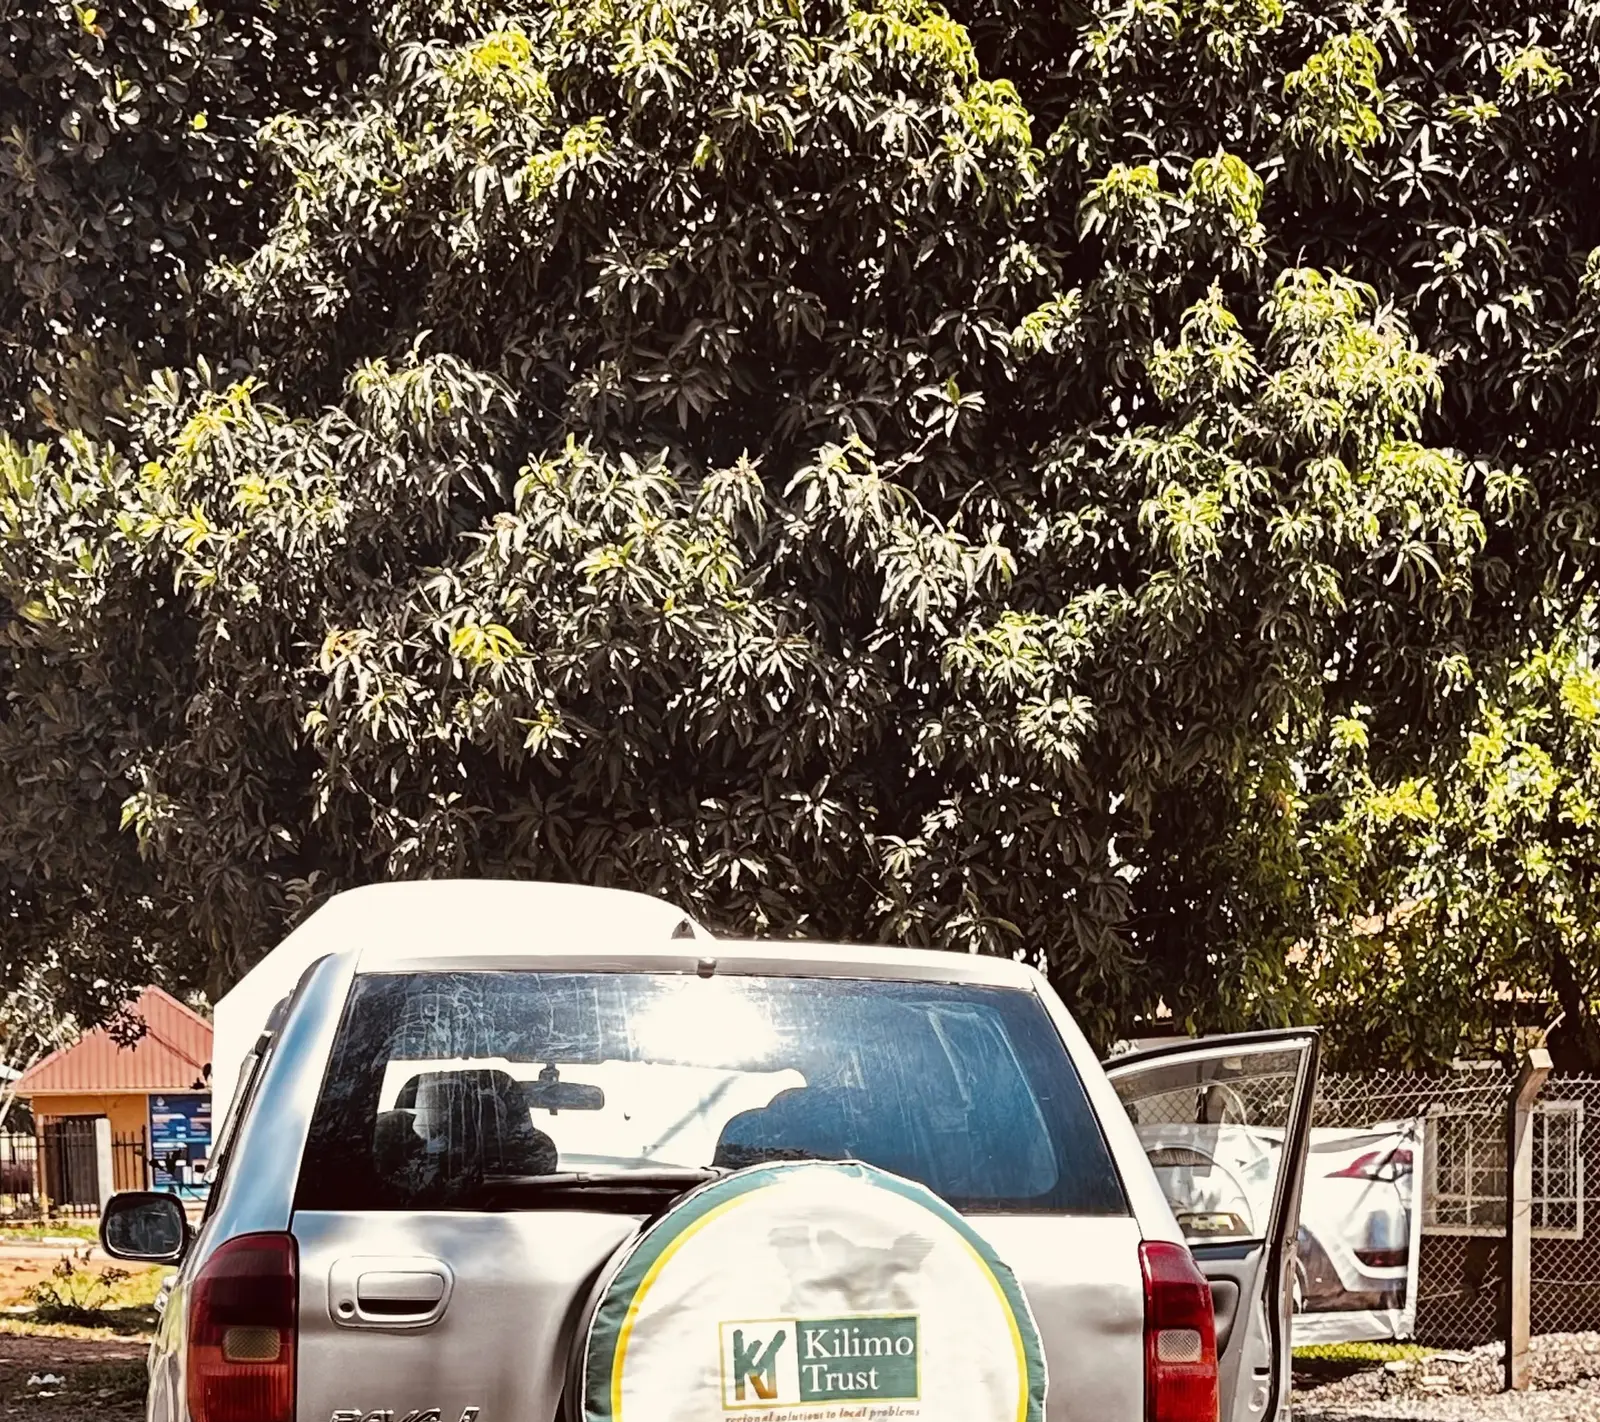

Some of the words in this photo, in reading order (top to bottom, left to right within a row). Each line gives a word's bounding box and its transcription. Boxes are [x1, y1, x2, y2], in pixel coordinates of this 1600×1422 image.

[803, 1328, 914, 1359] Kilimo
[802, 1364, 879, 1392] Trust
[775, 1411, 823, 1422] solutions
[826, 1410, 836, 1419] to
[839, 1407, 866, 1418] local
[868, 1405, 920, 1420] problems
